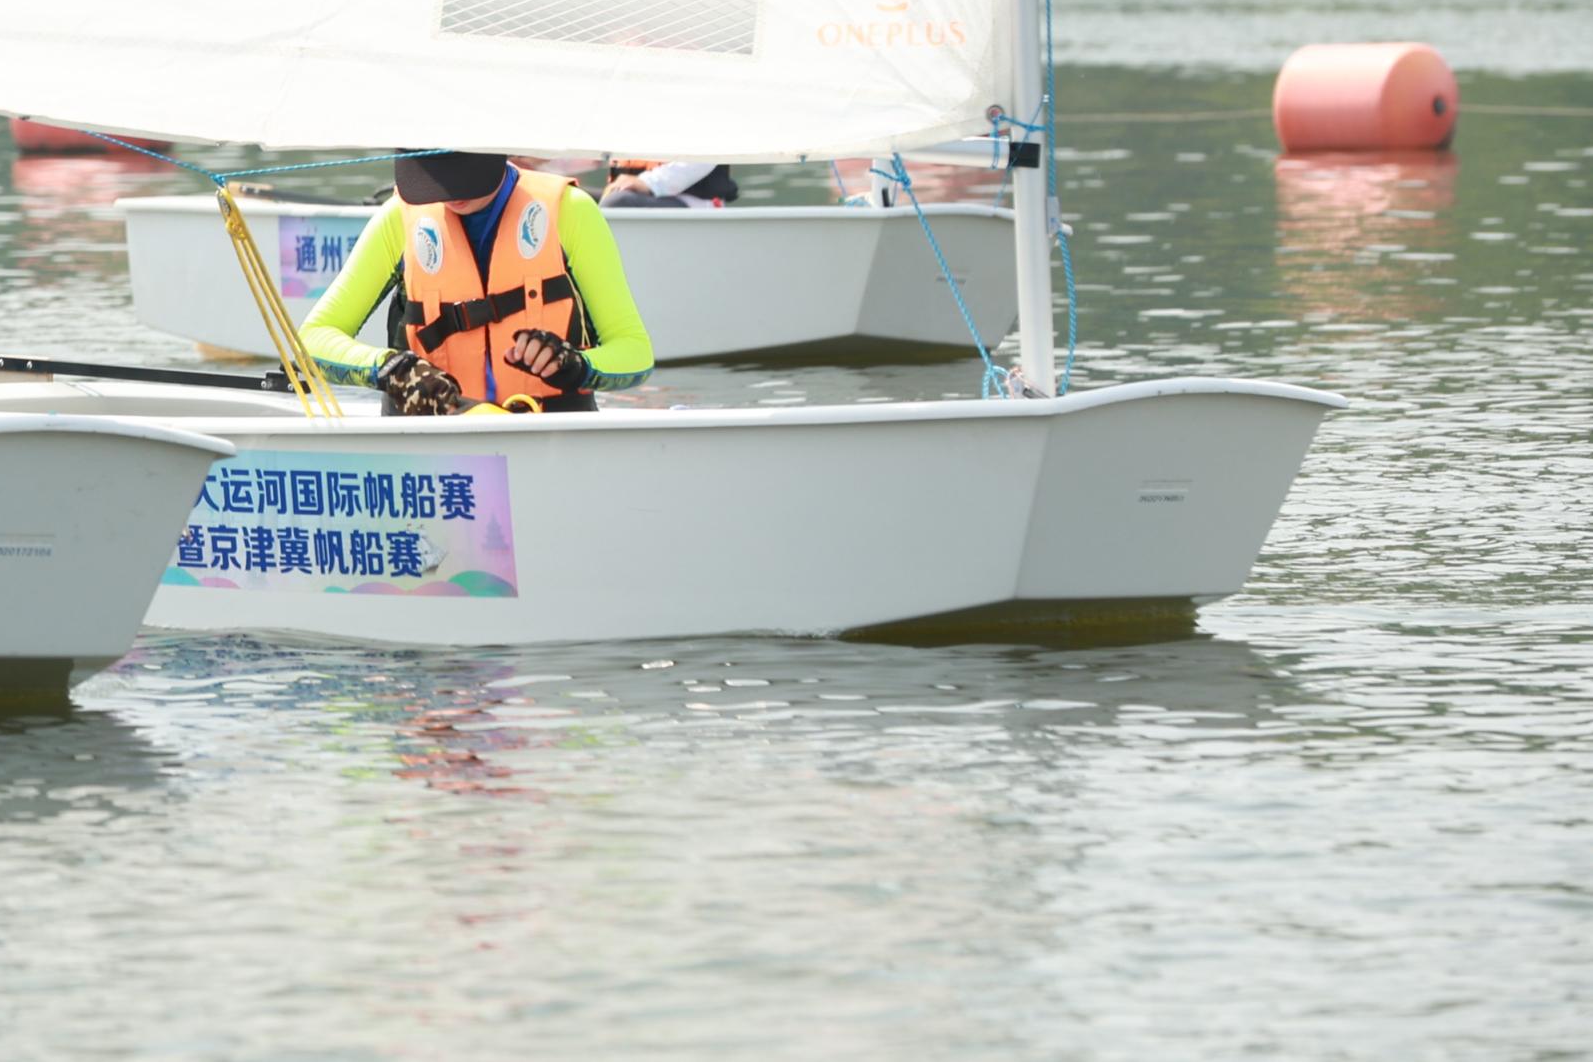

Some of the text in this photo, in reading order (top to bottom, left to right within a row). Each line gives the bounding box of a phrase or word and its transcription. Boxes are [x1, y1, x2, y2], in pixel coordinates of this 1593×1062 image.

[816, 20, 967, 48] ONEPLUS
[295, 234, 360, 273] 通州
[176, 524, 423, 578] 暨京津冀帆船赛
